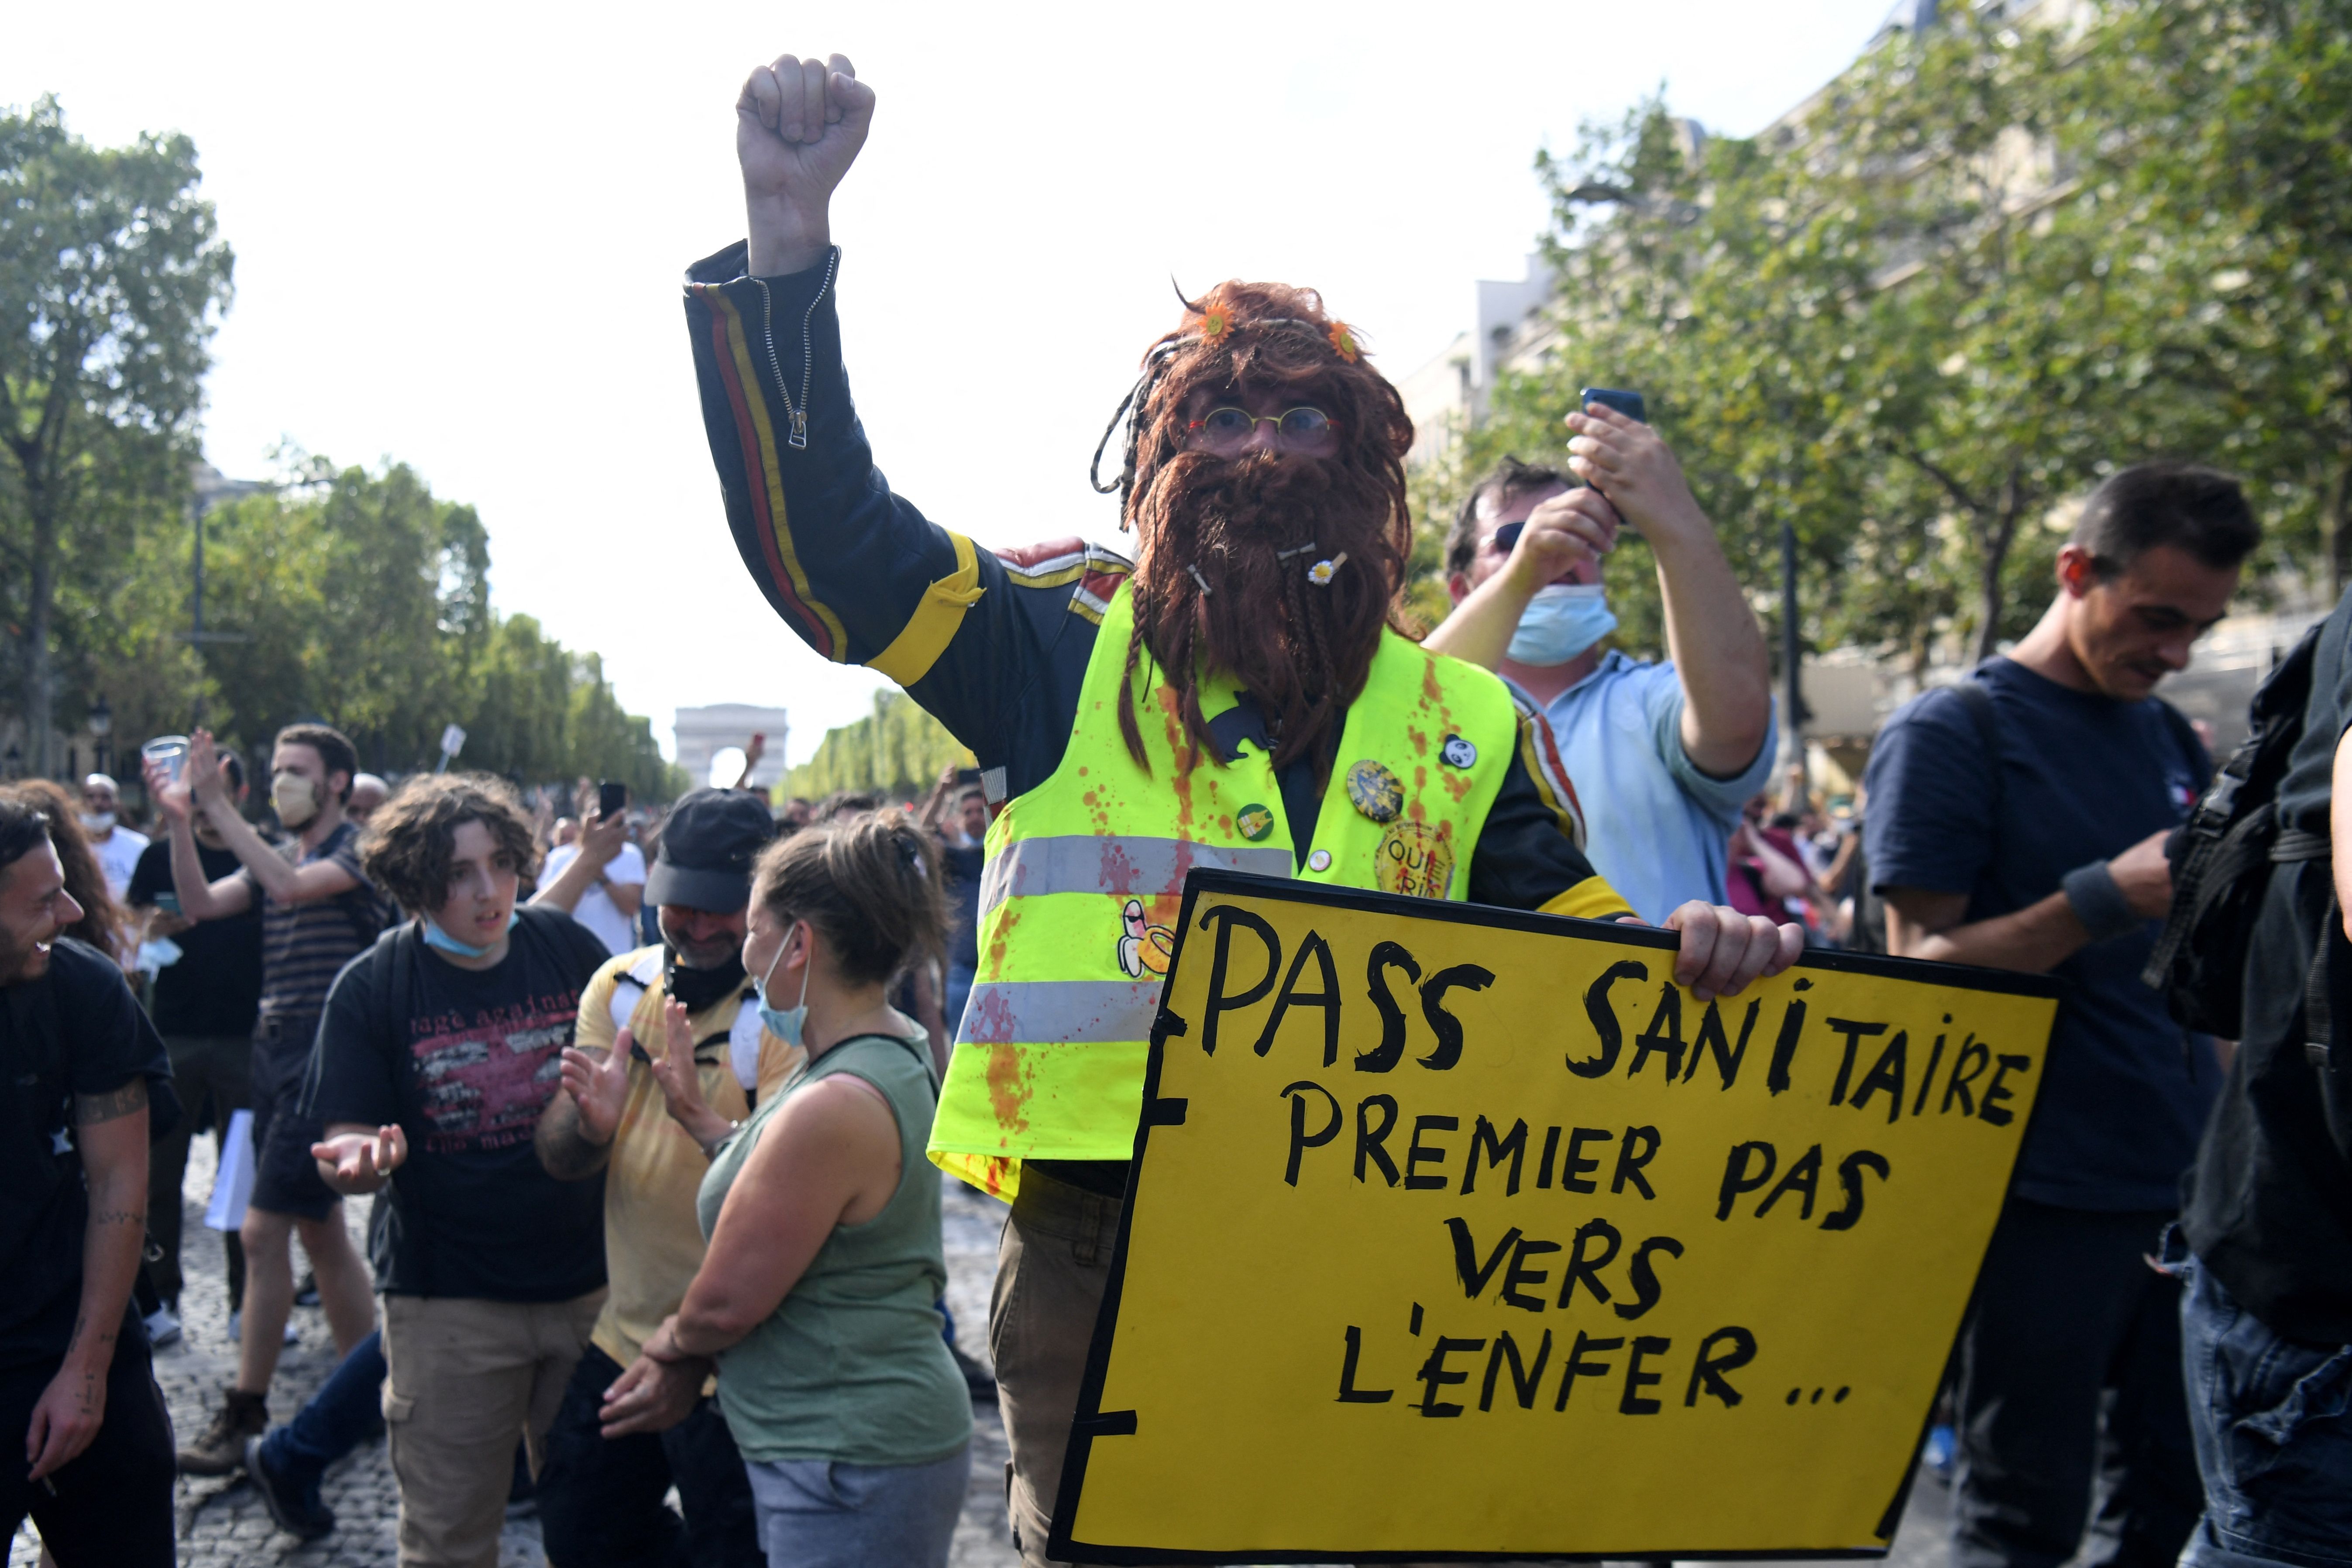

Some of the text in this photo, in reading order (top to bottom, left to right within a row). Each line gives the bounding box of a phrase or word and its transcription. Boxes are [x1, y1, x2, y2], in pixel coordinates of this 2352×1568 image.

[1389, 840, 1430, 872] OUI
[1199, 905, 1495, 1073] PASS
[1280, 1081, 1890, 1231] PREMIER PAS
[1444, 1217, 1684, 1320] VERS
